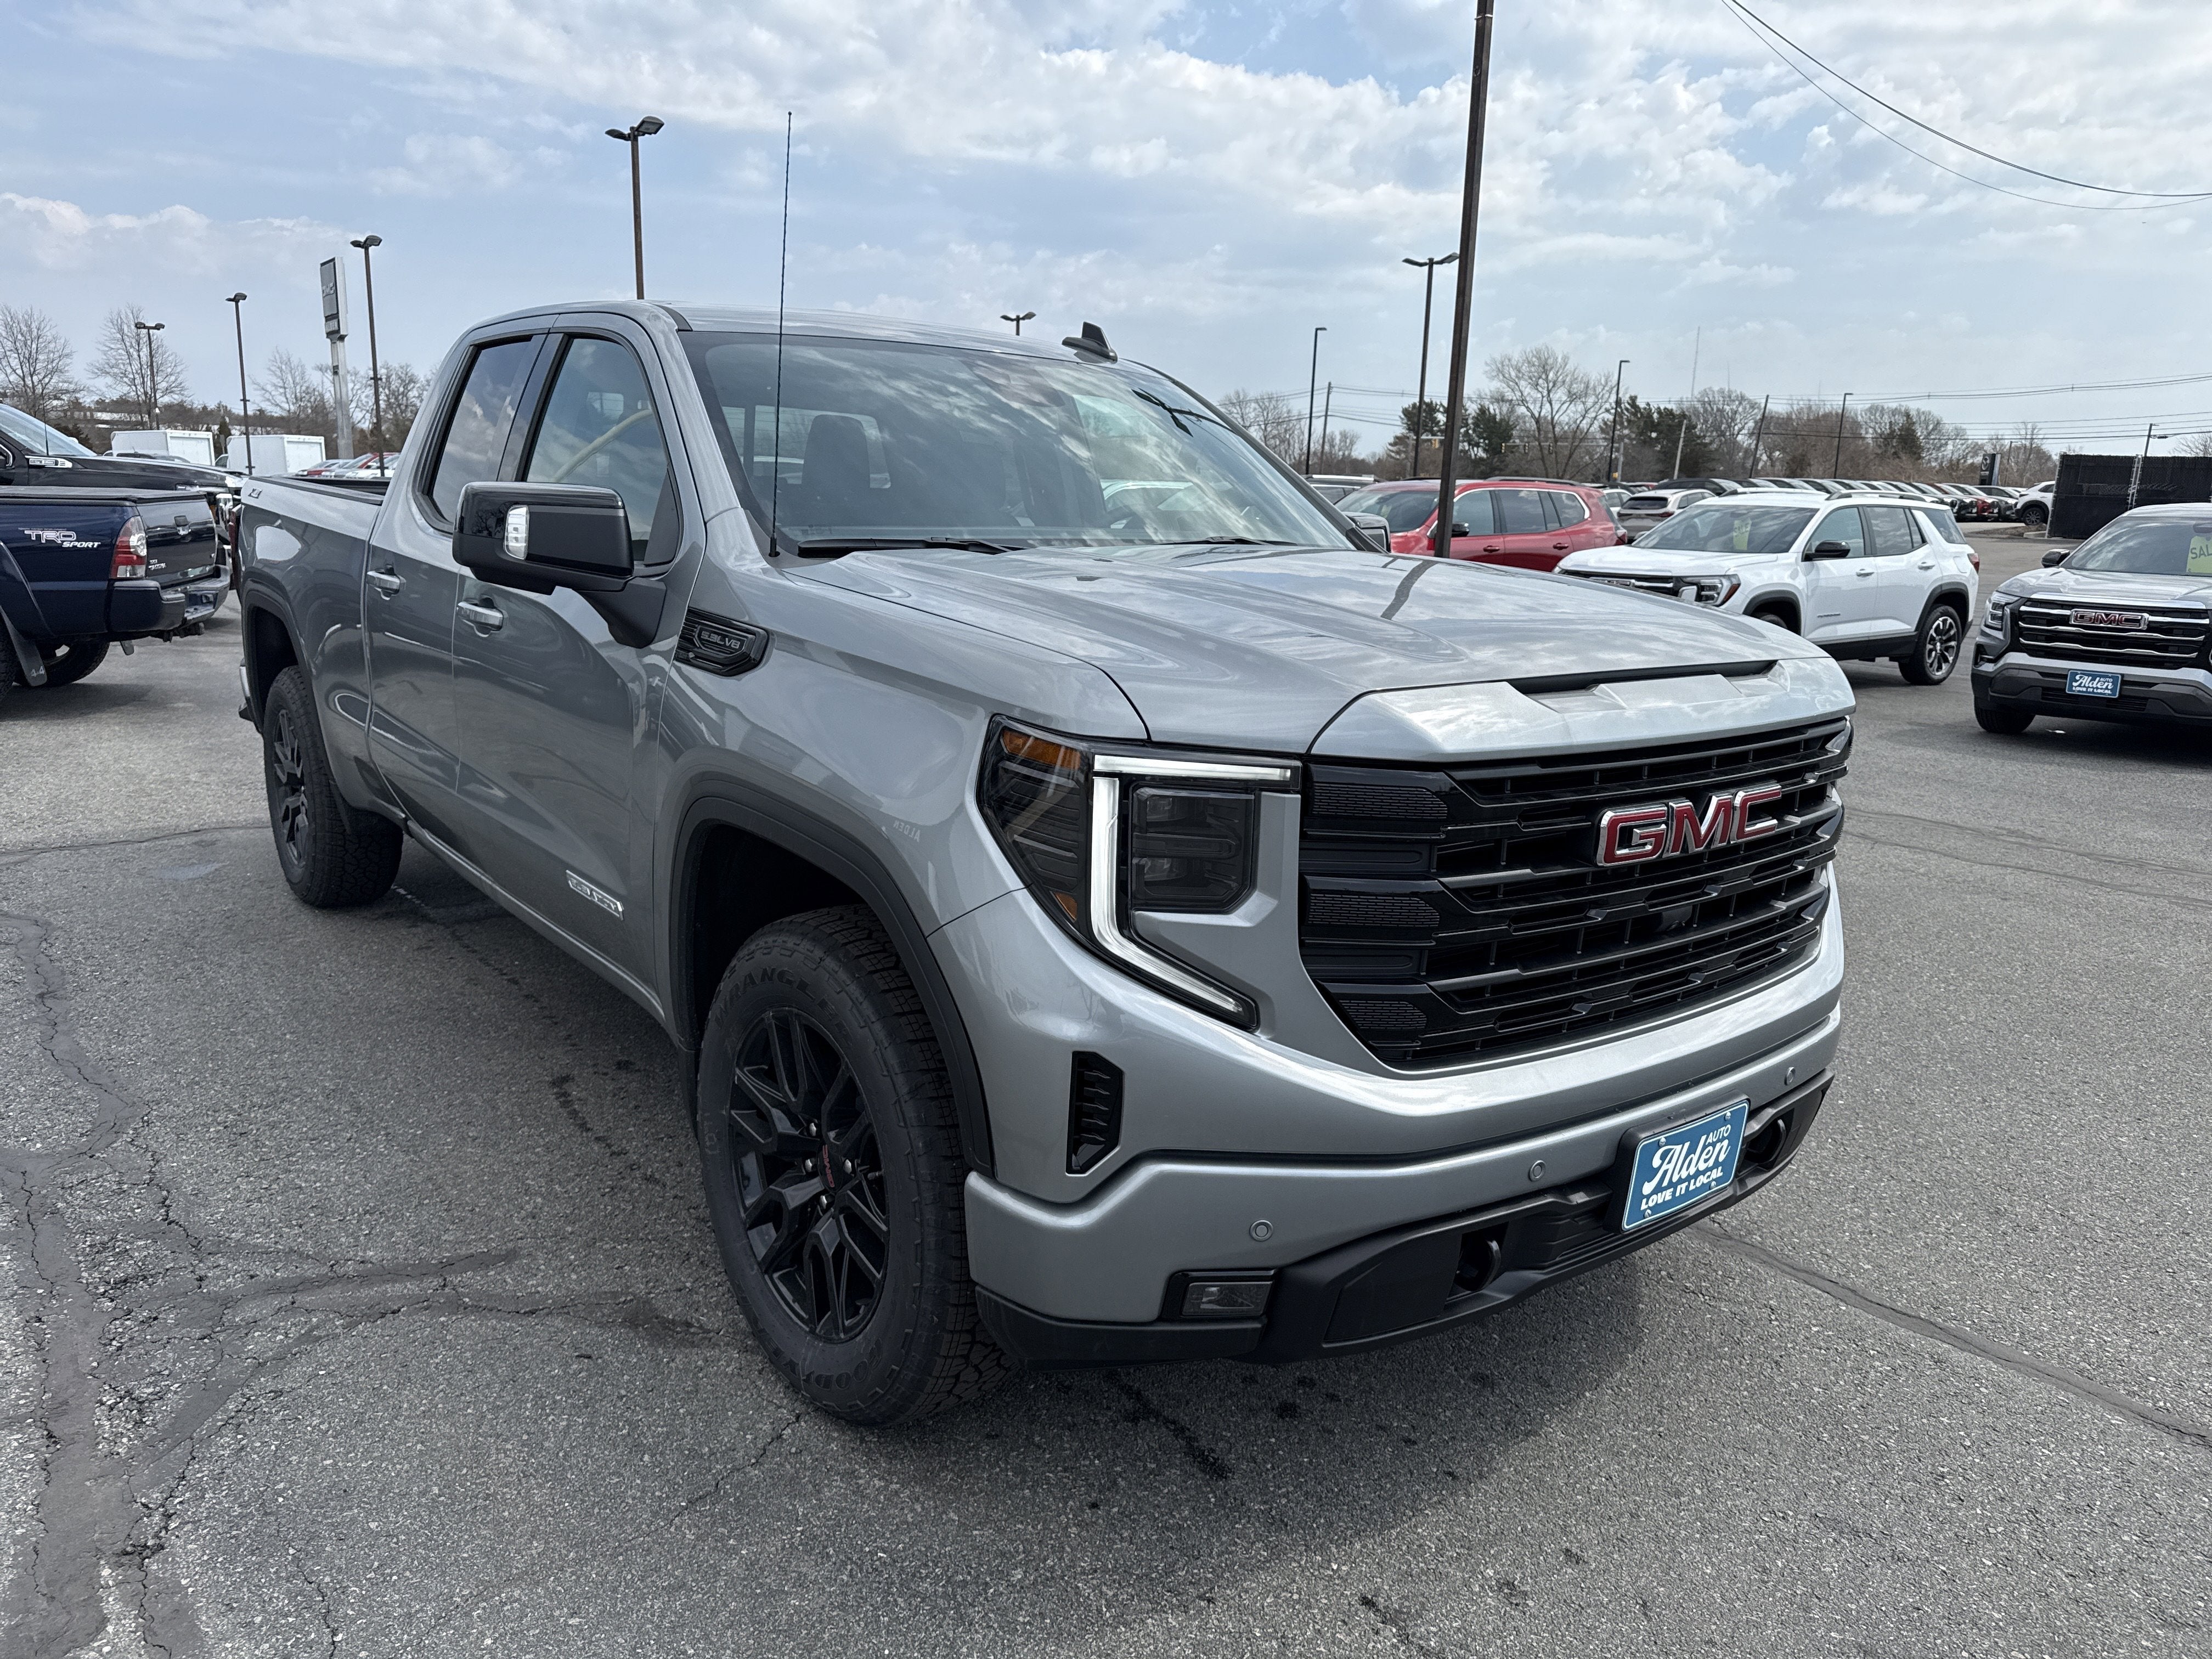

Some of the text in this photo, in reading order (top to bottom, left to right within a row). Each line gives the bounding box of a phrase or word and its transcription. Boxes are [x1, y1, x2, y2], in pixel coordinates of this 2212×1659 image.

[24, 530, 77, 544] TRD
[2074, 611, 2142, 627] GMC
[2072, 674, 2114, 689] Alden
[1595, 783, 1782, 867] GMC
[1642, 1124, 1731, 1195] Alden AUTO
[1640, 1166, 1723, 1210] LOVE IT LOCAL
